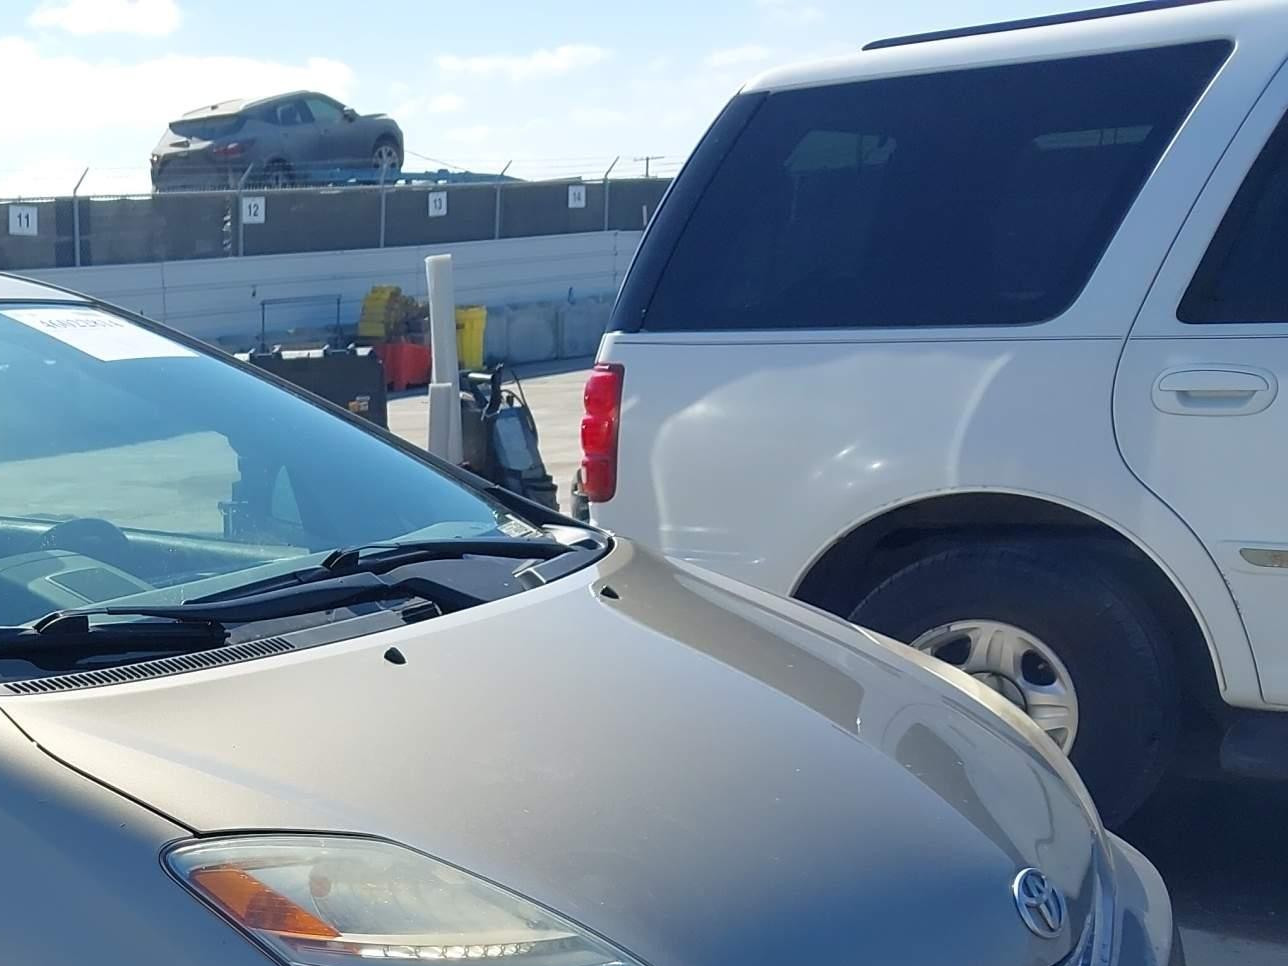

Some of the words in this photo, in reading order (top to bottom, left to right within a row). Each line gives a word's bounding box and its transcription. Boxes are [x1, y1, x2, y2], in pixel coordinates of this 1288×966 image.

[433, 197, 443, 211] 13
[572, 191, 582, 203] 14
[247, 203, 260, 217] 12
[17, 212, 30, 229] 11
